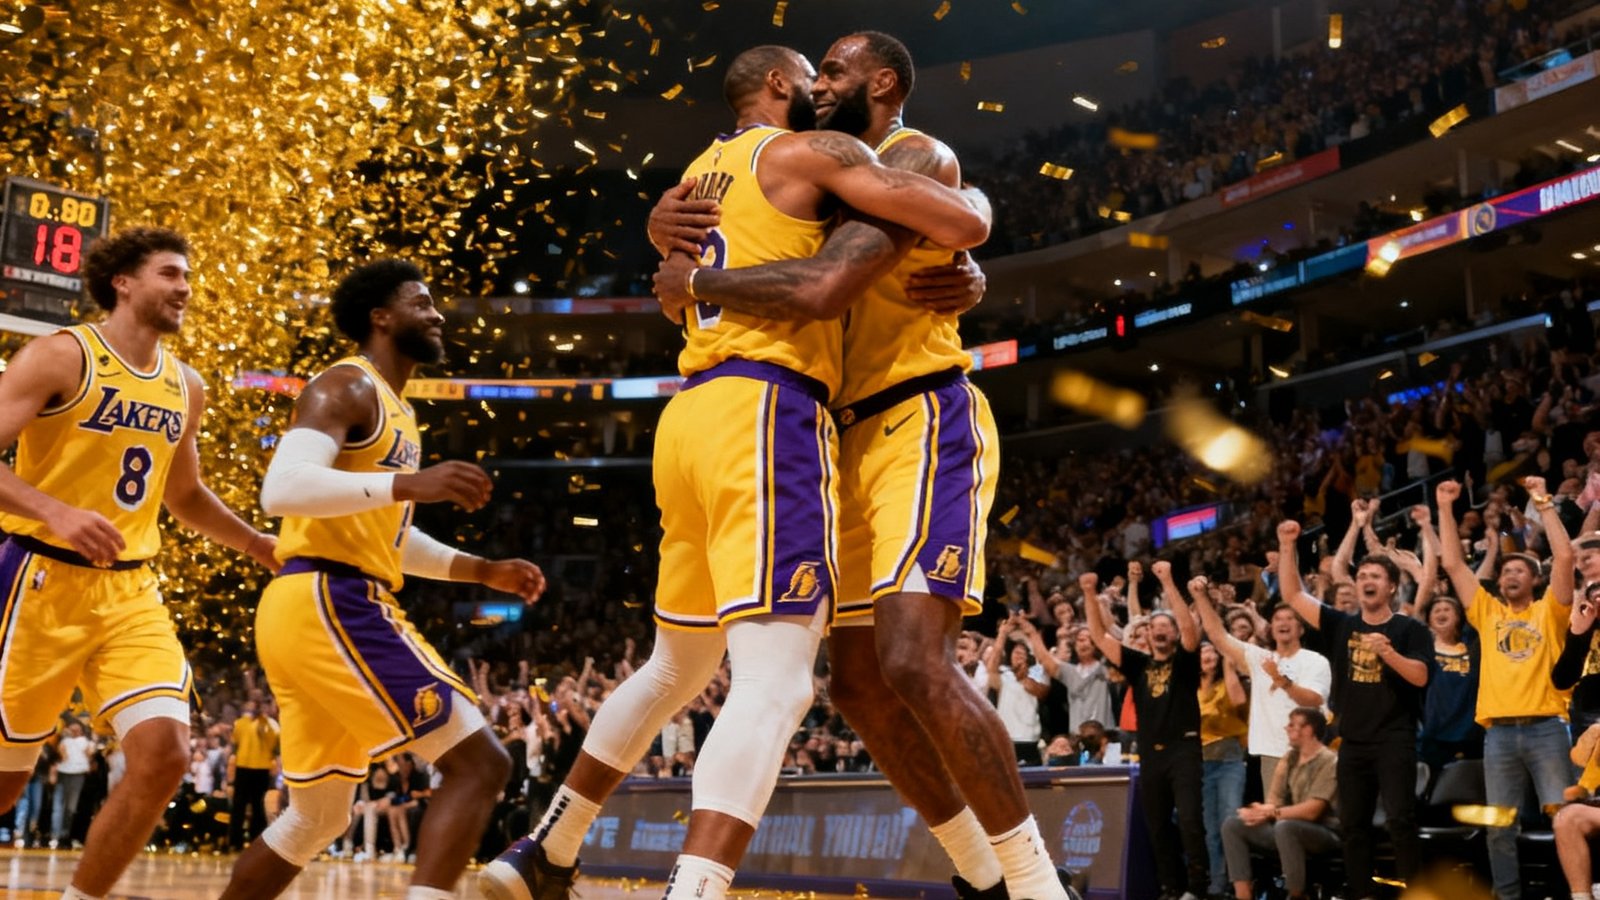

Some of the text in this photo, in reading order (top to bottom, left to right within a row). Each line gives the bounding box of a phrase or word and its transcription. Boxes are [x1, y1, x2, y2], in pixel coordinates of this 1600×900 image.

[33, 224, 83, 274] 18
[78, 385, 183, 444] LAKERS
[112, 445, 154, 512] 8
